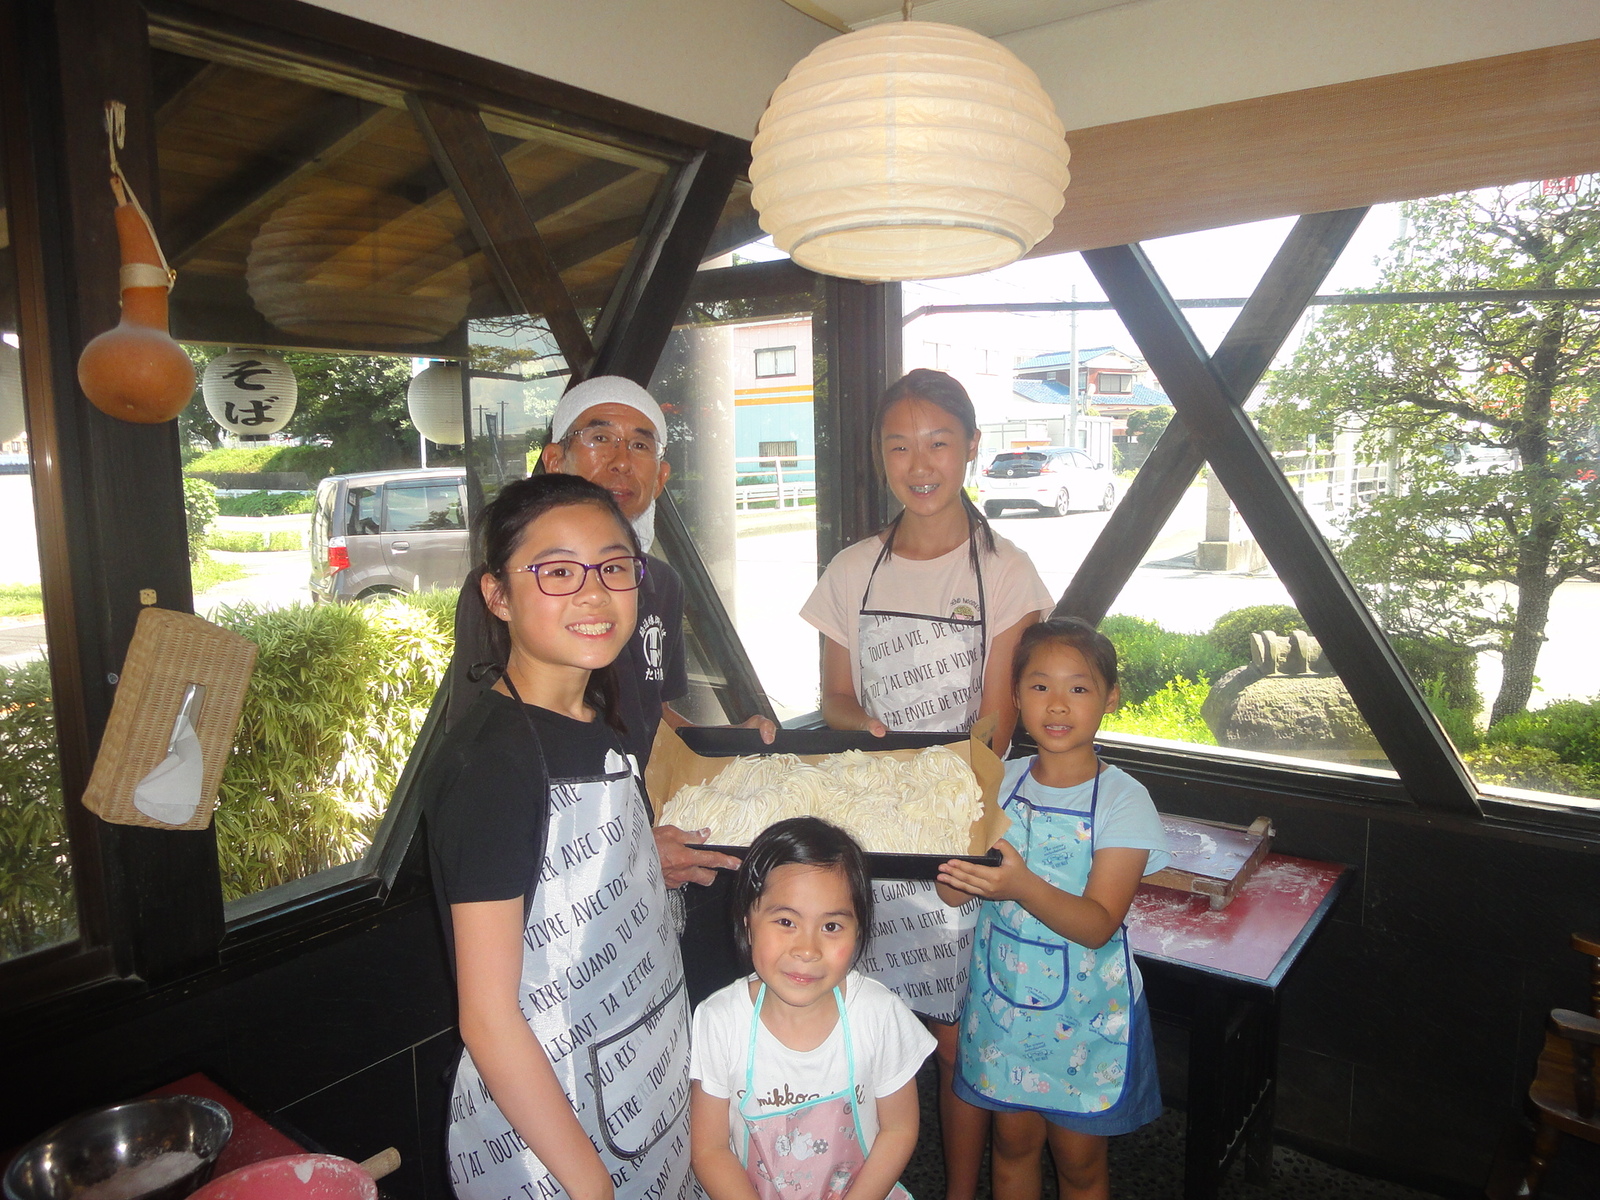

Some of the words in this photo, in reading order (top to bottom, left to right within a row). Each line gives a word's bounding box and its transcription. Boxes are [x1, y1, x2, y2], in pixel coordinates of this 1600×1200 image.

[222, 360, 279, 427] そば
[868, 641, 891, 663] TOUTE
[892, 636, 905, 653] LA
[905, 629, 929, 648] VIE,
[931, 622, 947, 639] DE
[882, 674, 903, 696] J'AI
[903, 663, 935, 686] ENVIE
[936, 658, 950, 675] DE
[950, 647, 978, 670] VIVRE
[883, 709, 904, 729] J'AI
[904, 699, 937, 723] ENVIE
[938, 694, 951, 711] DE
[952, 687, 972, 706] RIRE
[561, 832, 600, 869] AVEC
[597, 815, 625, 846] TOI
[524, 912, 570, 952] VIVRE
[571, 889, 609, 927] AVEC
[604, 871, 629, 902] TOI
[900, 916, 916, 931] TA
[917, 909, 949, 930] LETTRE
[528, 980, 568, 1014] RIRE
[615, 918, 633, 944] TU
[630, 897, 650, 927] RIS
[861, 957, 884, 973] VIE,
[886, 952, 901, 969] DE
[901, 948, 932, 966] RESTER
[933, 942, 956, 960] AVEC
[956, 934, 970, 951] TOI
[904, 980, 933, 999] VIVRE
[936, 976, 957, 994] AVEC
[956, 966, 969, 986] TOI
[544, 1012, 598, 1063] LISANT
[599, 992, 620, 1016] TA
[621, 951, 656, 997] LETTRE
[614, 1040, 637, 1071] RIS
[463, 1089, 477, 1116] LA
[606, 1095, 643, 1138] ETTRE
[647, 1046, 672, 1090] TOUTE
[458, 1151, 486, 1184] J'AI
[483, 1129, 530, 1165] TOUTE
[610, 1166, 631, 1189] DE
[640, 1158, 672, 1200] ISANT
[671, 1135, 684, 1157] TA
[521, 1173, 561, 1200] J'AI
